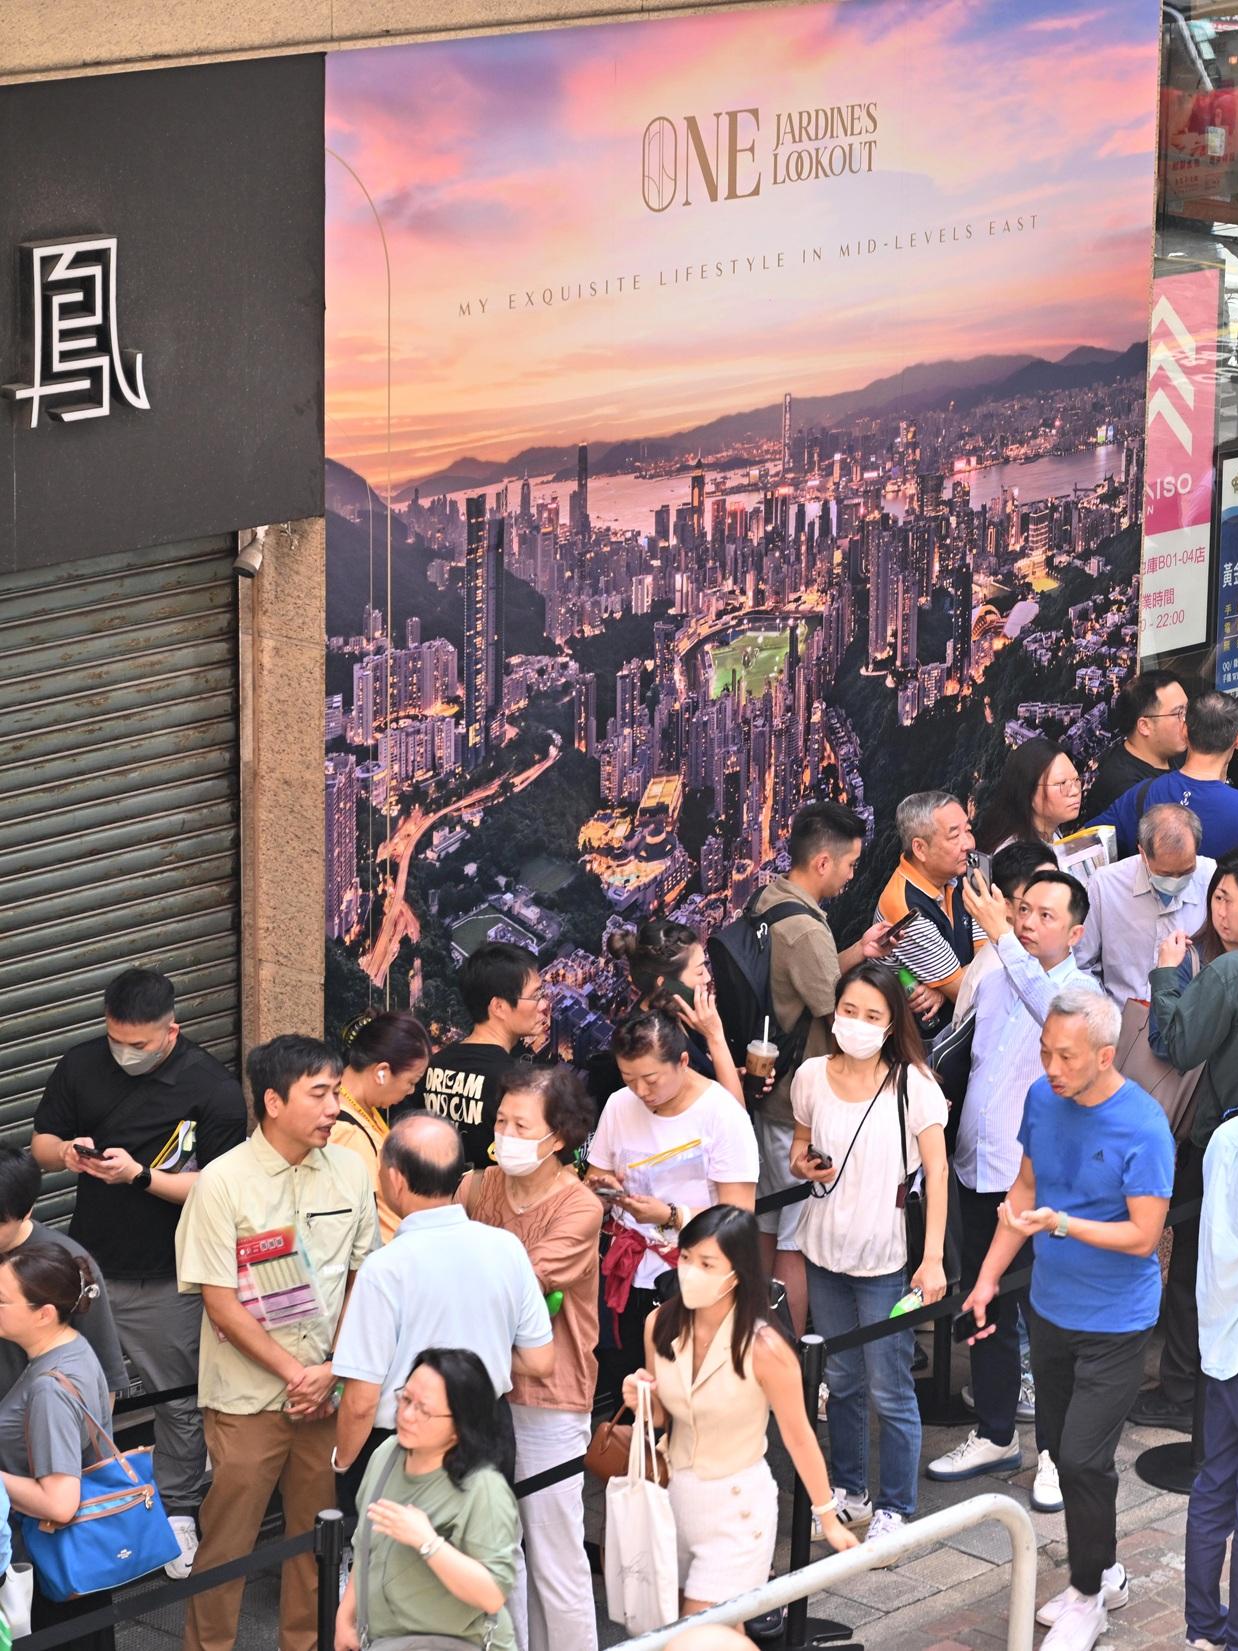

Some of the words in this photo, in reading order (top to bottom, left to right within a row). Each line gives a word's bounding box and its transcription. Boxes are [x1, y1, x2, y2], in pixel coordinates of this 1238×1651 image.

[773, 101, 879, 152] JARDINE'S
[641, 107, 761, 213] ONE
[771, 139, 878, 187] LOOKOUT
[458, 296, 489, 319] MY
[508, 273, 642, 311] EXQUISITE
[659, 249, 788, 287] LIFESTYLE
[802, 248, 824, 264] IN
[839, 223, 974, 260] MID-LEVELS
[988, 213, 1041, 235] EAST
[1156, 609, 1185, 628] 22:00
[425, 1067, 485, 1100] DREAM
[449, 1096, 484, 1126] CAN
